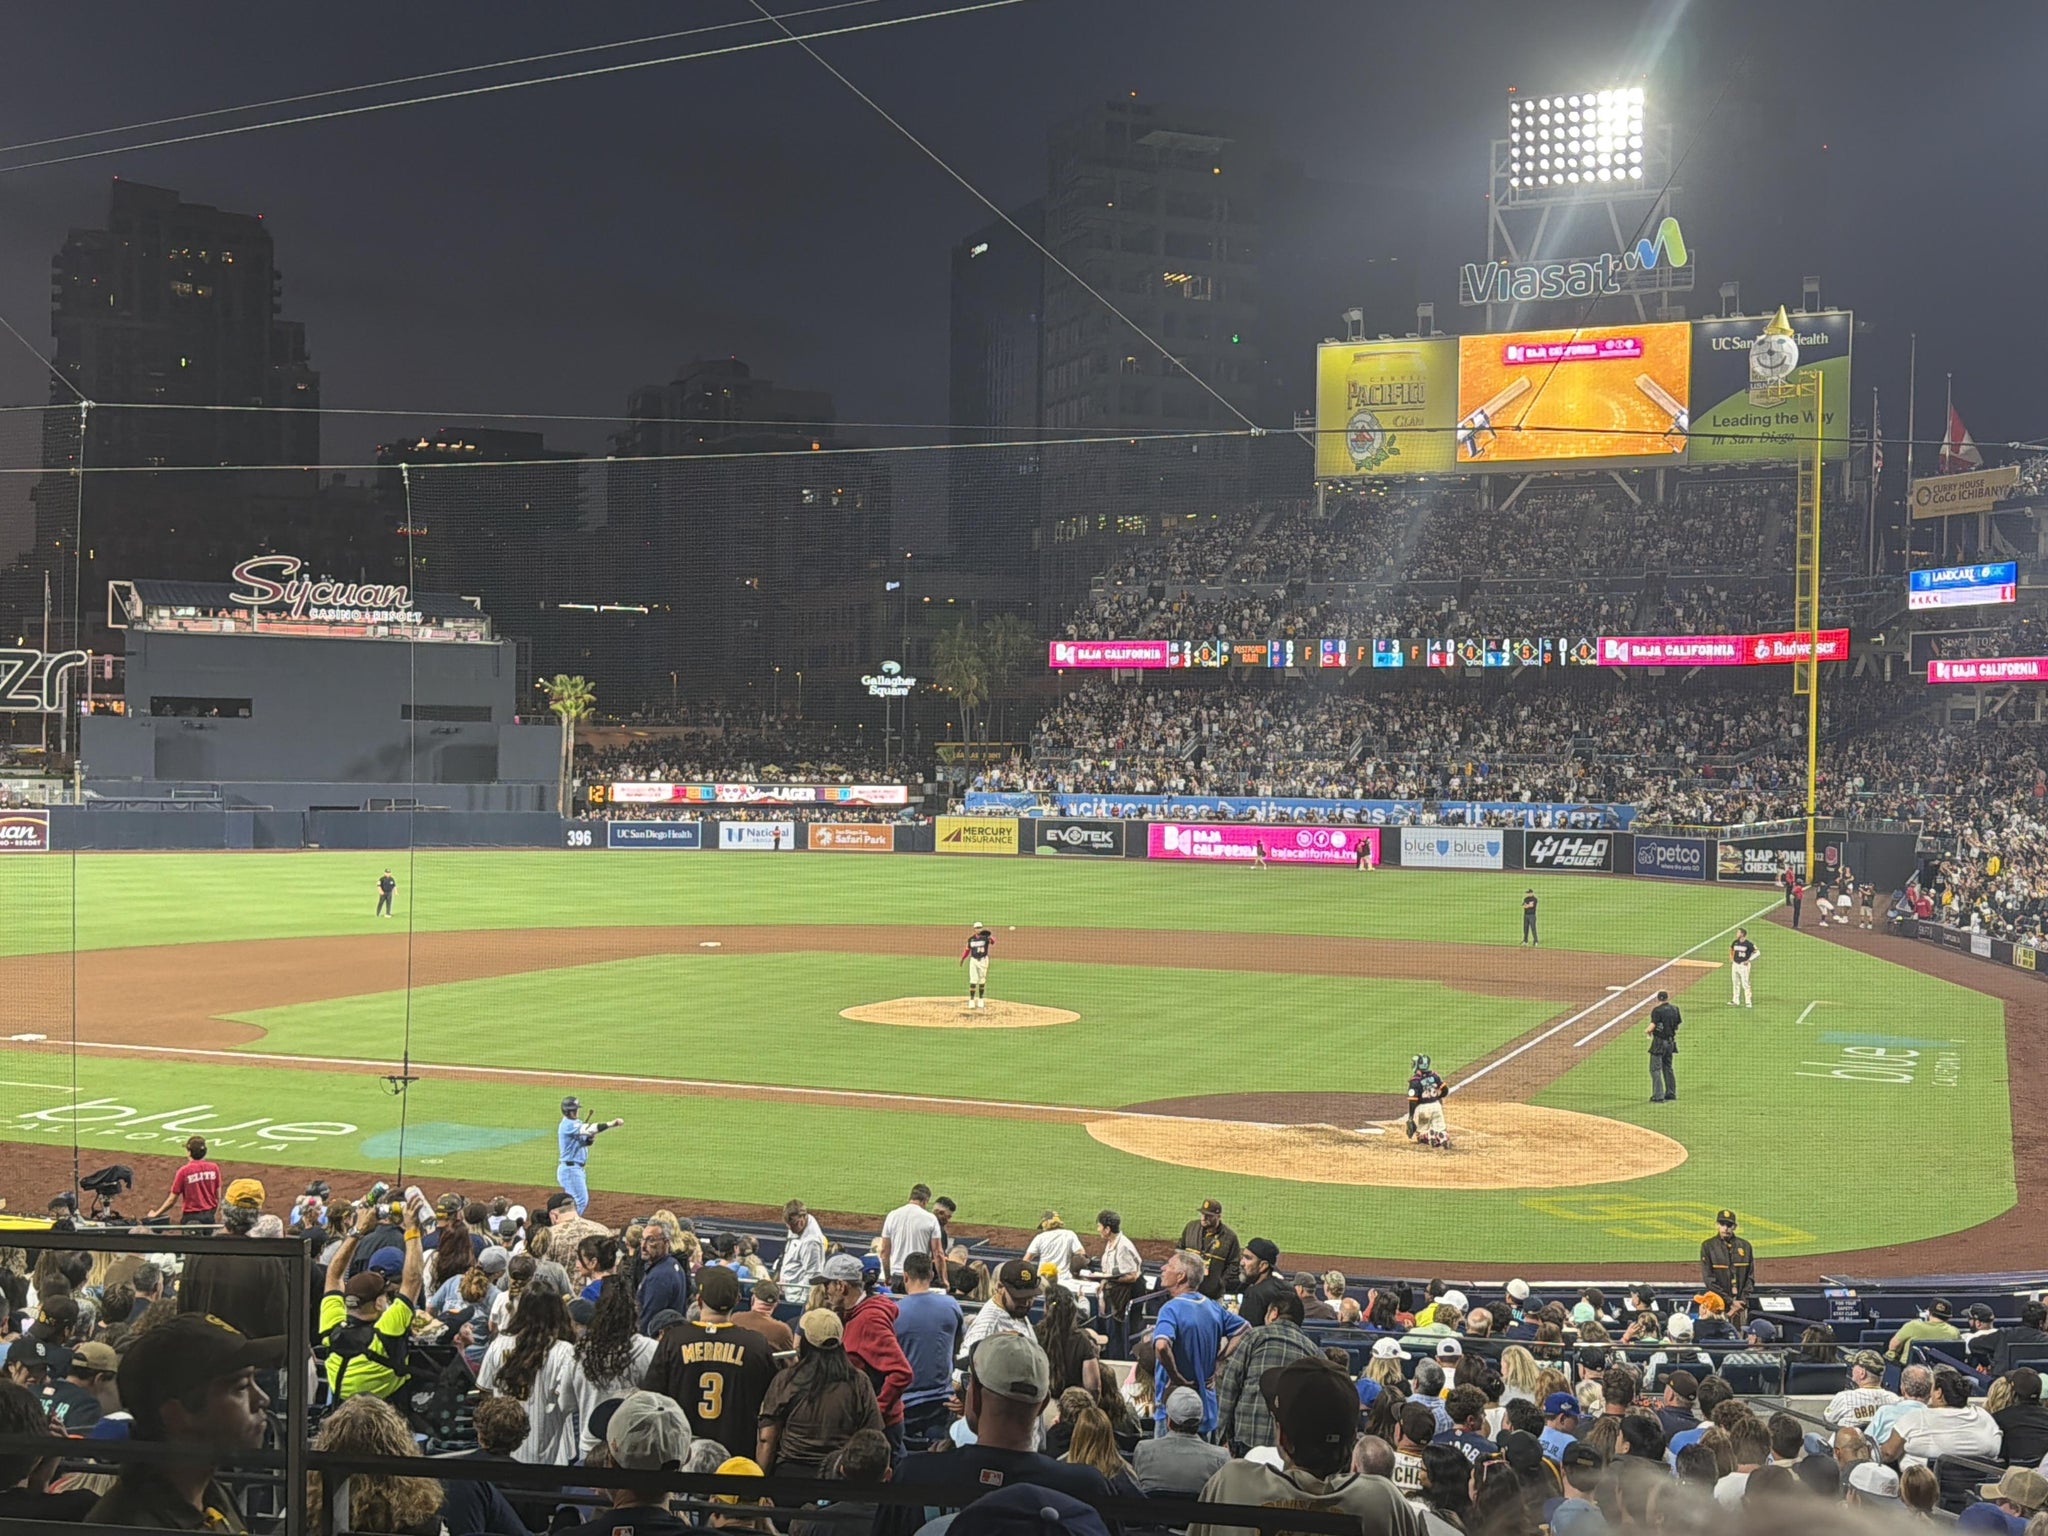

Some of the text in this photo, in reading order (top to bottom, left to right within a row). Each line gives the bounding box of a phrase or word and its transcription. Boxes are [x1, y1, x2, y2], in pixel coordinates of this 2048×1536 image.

[1465, 253, 1620, 303] Viasat
[1712, 336, 1731, 350] UC
[1713, 411, 1771, 427] Leading
[1775, 411, 1799, 424] the
[1960, 479, 1984, 489] HOUSE
[229, 555, 414, 618] Sycuan
[309, 607, 422, 622] CASINO RESORT
[1077, 647, 1161, 660] BAJA CALIFORNIA
[1632, 643, 1735, 656] BAJA CALIFORNIA
[1773, 640, 1837, 657] Budweser
[1952, 661, 2039, 677] BAJA CALIFORNIA
[861, 675, 917, 688] Gallagher
[869, 685, 909, 698] Square
[567, 830, 592, 846] 396
[617, 829, 693, 841] UC San Diego Health
[747, 827, 790, 838] Natioal
[963, 826, 1012, 836] MERCURY
[1047, 826, 1114, 845] EVOTEK
[1193, 830, 1222, 843] BAJA
[835, 834, 887, 845] Safari Park
[963, 836, 1013, 844] INSURANCE
[1404, 839, 1435, 852] blue
[1454, 840, 1486, 853] blue
[1558, 837, 1610, 856] H2O
[1553, 856, 1602, 867] POWER
[1656, 843, 1700, 866] petco
[1744, 848, 1773, 862] SLAP
[1775, 850, 1806, 864] OME
[18, 1098, 358, 1142] blue
[187, 1170, 216, 1184] ELITE
[681, 1341, 746, 1367] MERRILL
[698, 1372, 724, 1419] 3
